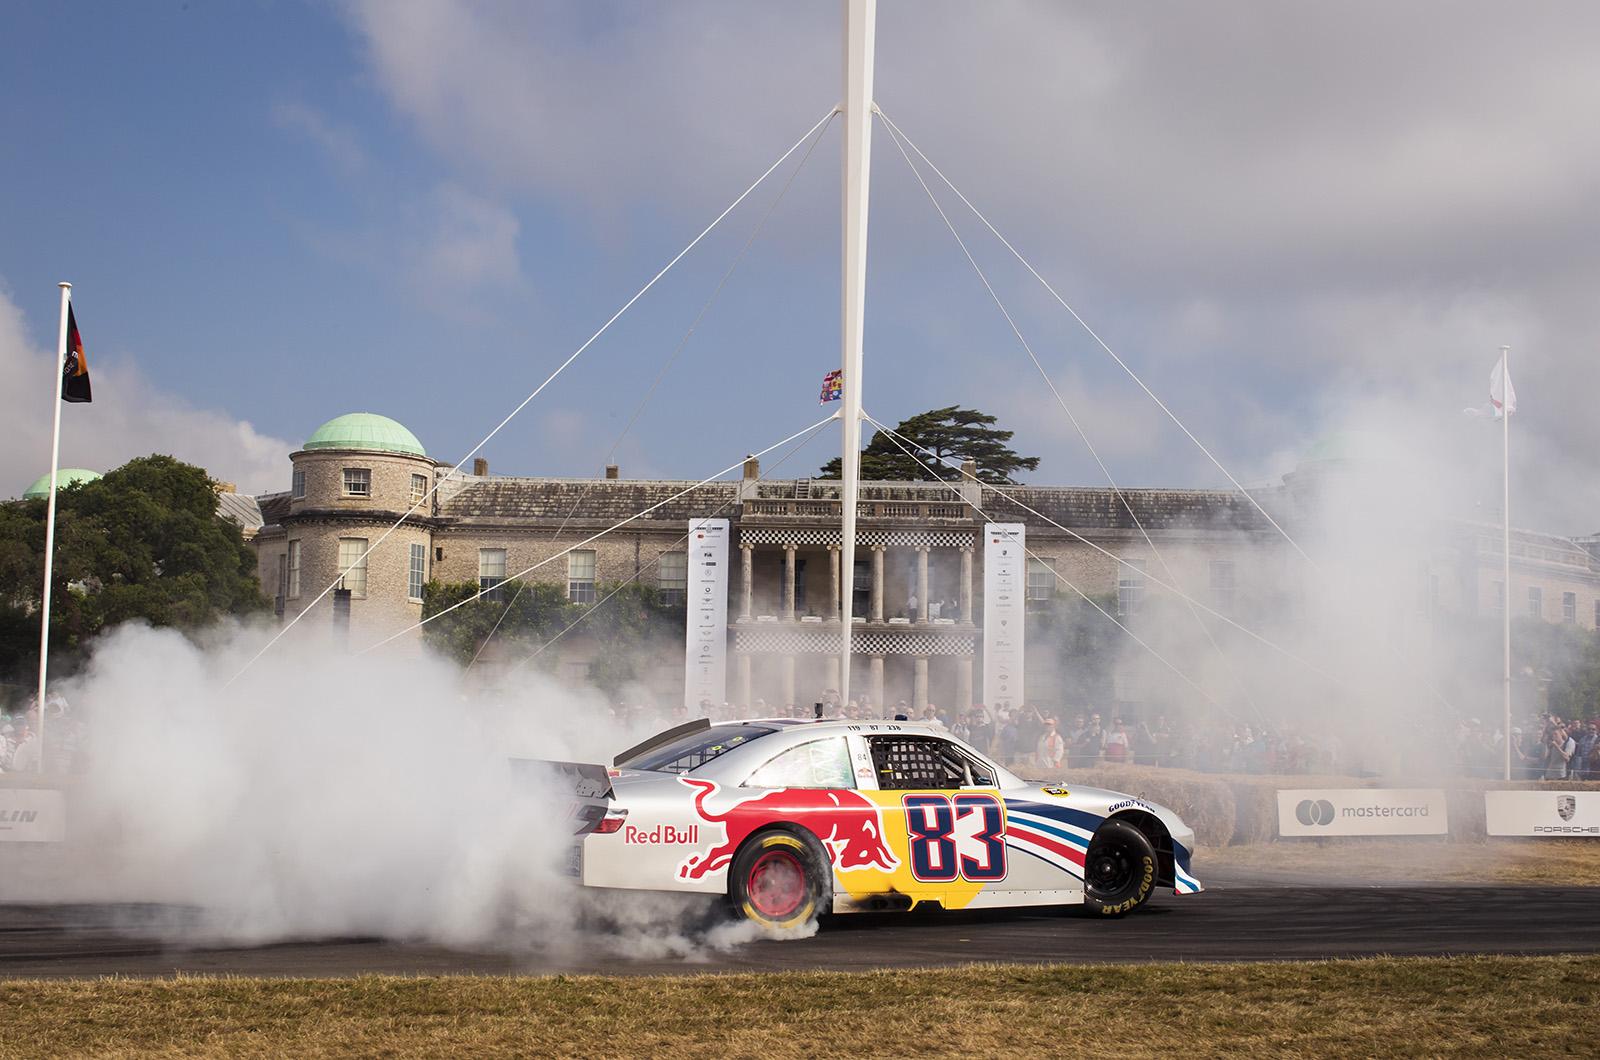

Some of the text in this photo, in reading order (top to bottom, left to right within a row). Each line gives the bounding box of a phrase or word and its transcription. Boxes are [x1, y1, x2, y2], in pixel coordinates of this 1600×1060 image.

[1342, 803, 1429, 818] mastercard
[625, 825, 698, 844] Red Bull
[901, 793, 1008, 883] 83
